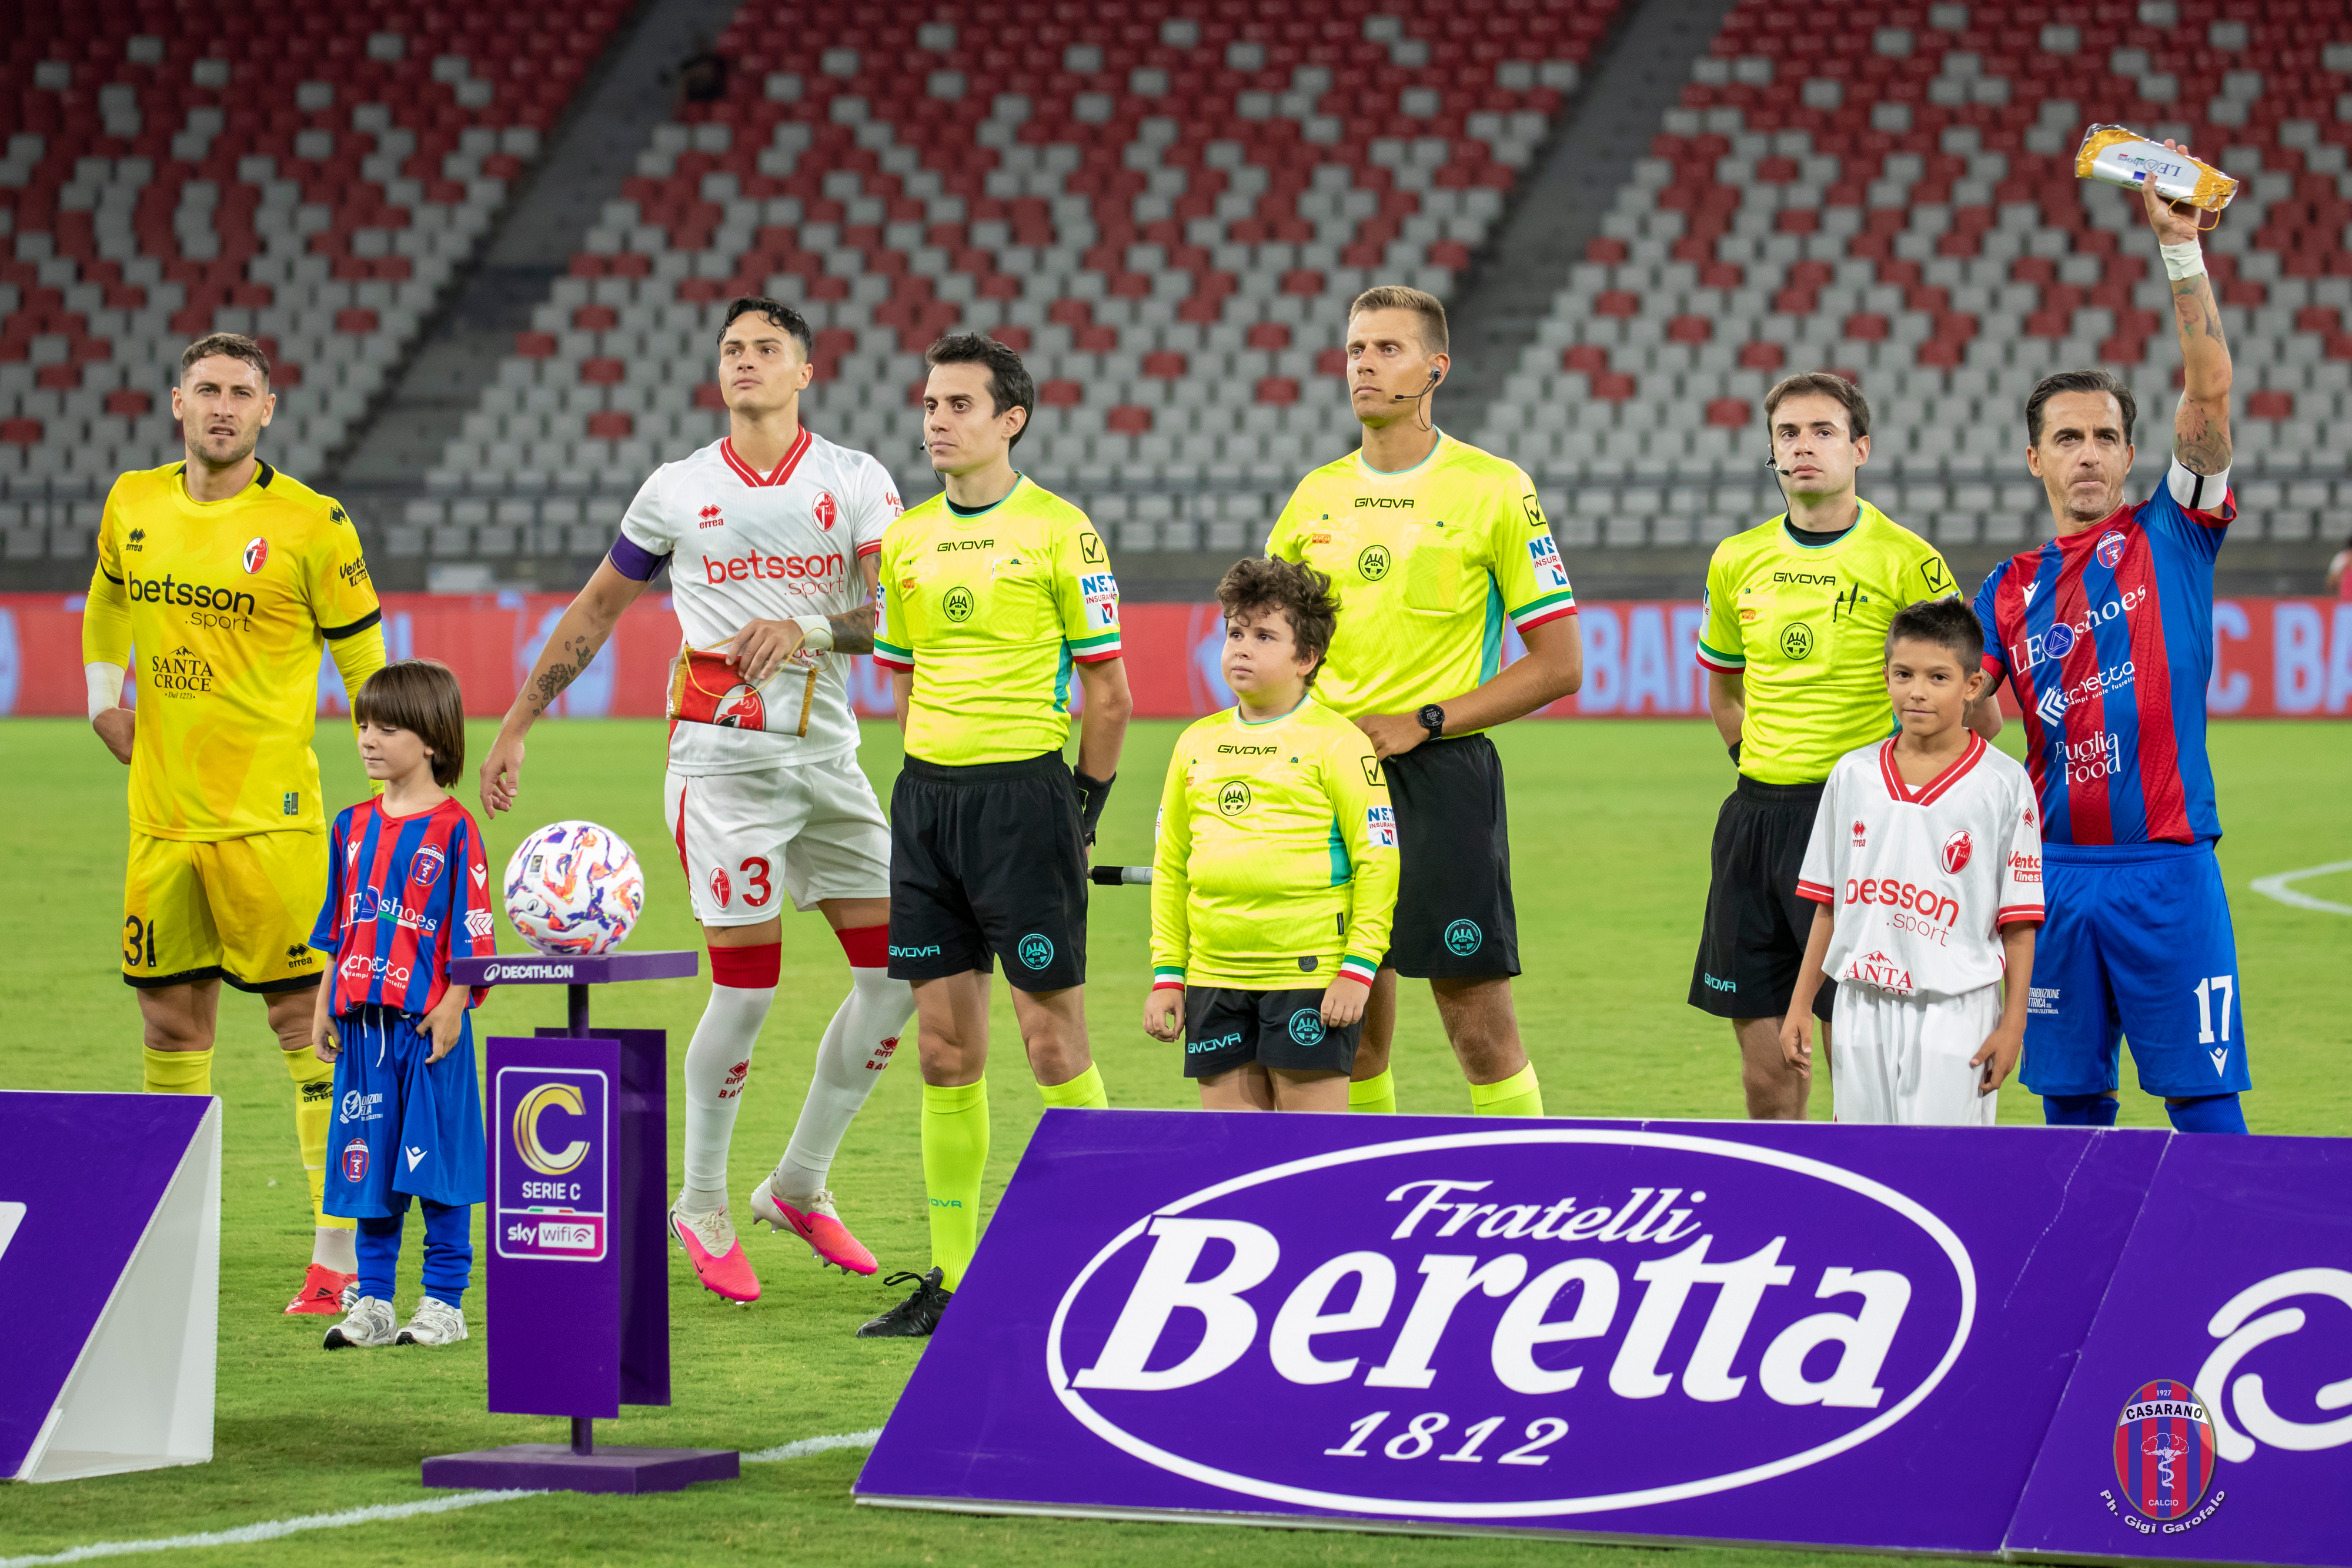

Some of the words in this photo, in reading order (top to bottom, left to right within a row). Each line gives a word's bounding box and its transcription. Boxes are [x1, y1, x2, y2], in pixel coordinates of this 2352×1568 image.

[1355, 497, 1414, 508] GIVOVA
[699, 518, 724, 529] errea
[126, 543, 142, 551] errea
[937, 539, 994, 551] GIVOVA
[703, 549, 843, 584] betsson
[1364, 554, 1384, 567] AIA
[784, 577, 844, 598] .sport
[1773, 572, 1836, 586] GIVOVA
[129, 571, 255, 615] betsson
[948, 595, 967, 609] AIA
[1086, 594, 1117, 604] INSURANC
[185, 611, 252, 631] .sport
[1786, 632, 1806, 646] AIA
[152, 656, 215, 677] SANTA
[154, 674, 211, 691] CROCE
[2092, 689, 2109, 699] suole
[2111, 676, 2136, 691] fustelle
[1218, 744, 1277, 755] GIVOVA
[2054, 731, 2118, 762] Puglia
[2064, 755, 2122, 785] Food
[1224, 790, 1244, 803] AIA
[420, 848, 443, 861] CASARANO
[739, 856, 771, 907] 3
[1844, 874, 1959, 927] besson
[379, 896, 437, 931] shoes
[1451, 928, 1475, 943] AIA
[1886, 913, 1949, 947] .sport
[124, 915, 157, 968] 31
[1025, 942, 1048, 957] AIA
[888, 945, 940, 957] GIVOVA
[288, 957, 313, 968] errea
[502, 965, 574, 978] DECATHLON
[383, 975, 406, 989] fustelle
[1844, 961, 1913, 989] ANTA
[2029, 987, 2061, 999] TRIBUZIONE
[2193, 975, 2233, 1044] 17
[1296, 1018, 1320, 1032] AIA
[513, 1083, 590, 1175] C
[522, 1181, 566, 1200] SERIE
[570, 1183, 581, 1201] C
[1385, 1179, 1707, 1245] Fratelli
[507, 1222, 537, 1245] sky
[542, 1225, 571, 1242] wifi
[1072, 1216, 1912, 1408] Beretta
[1324, 1410, 1569, 1466] 1812
